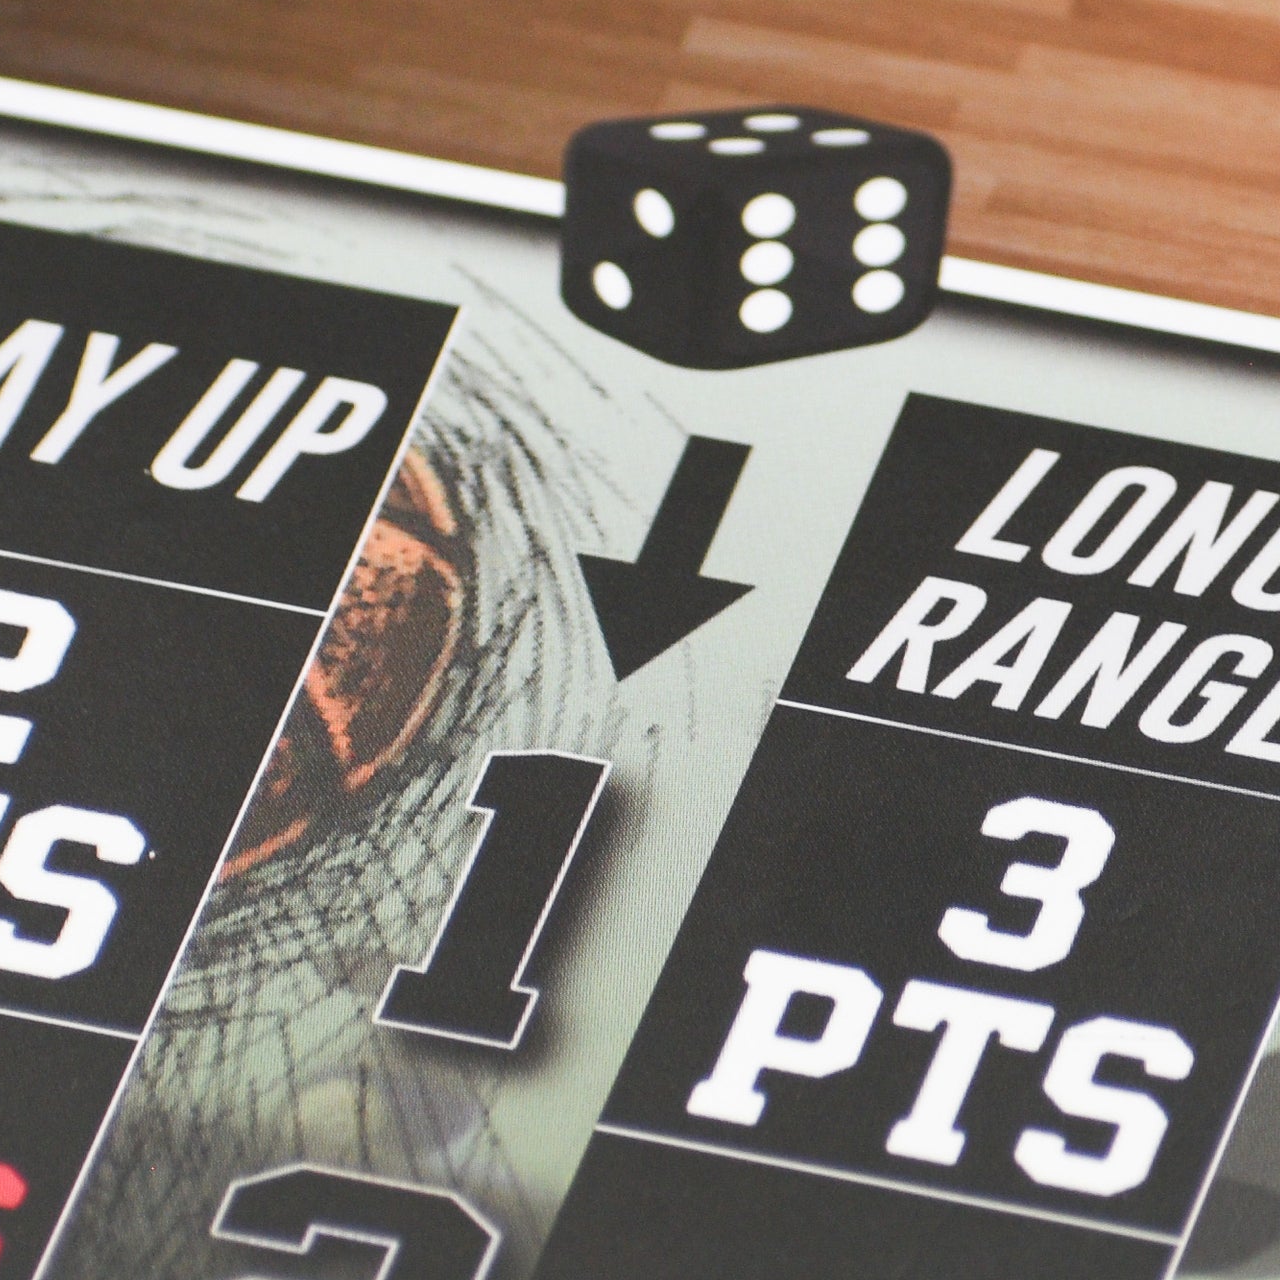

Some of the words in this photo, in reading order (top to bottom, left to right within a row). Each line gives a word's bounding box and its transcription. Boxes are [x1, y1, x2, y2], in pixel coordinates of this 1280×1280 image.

[152, 359, 386, 502] UP
[371, 749, 610, 1049] 1
[938, 796, 1115, 971] 3
[686, 949, 1196, 1198] PTS
